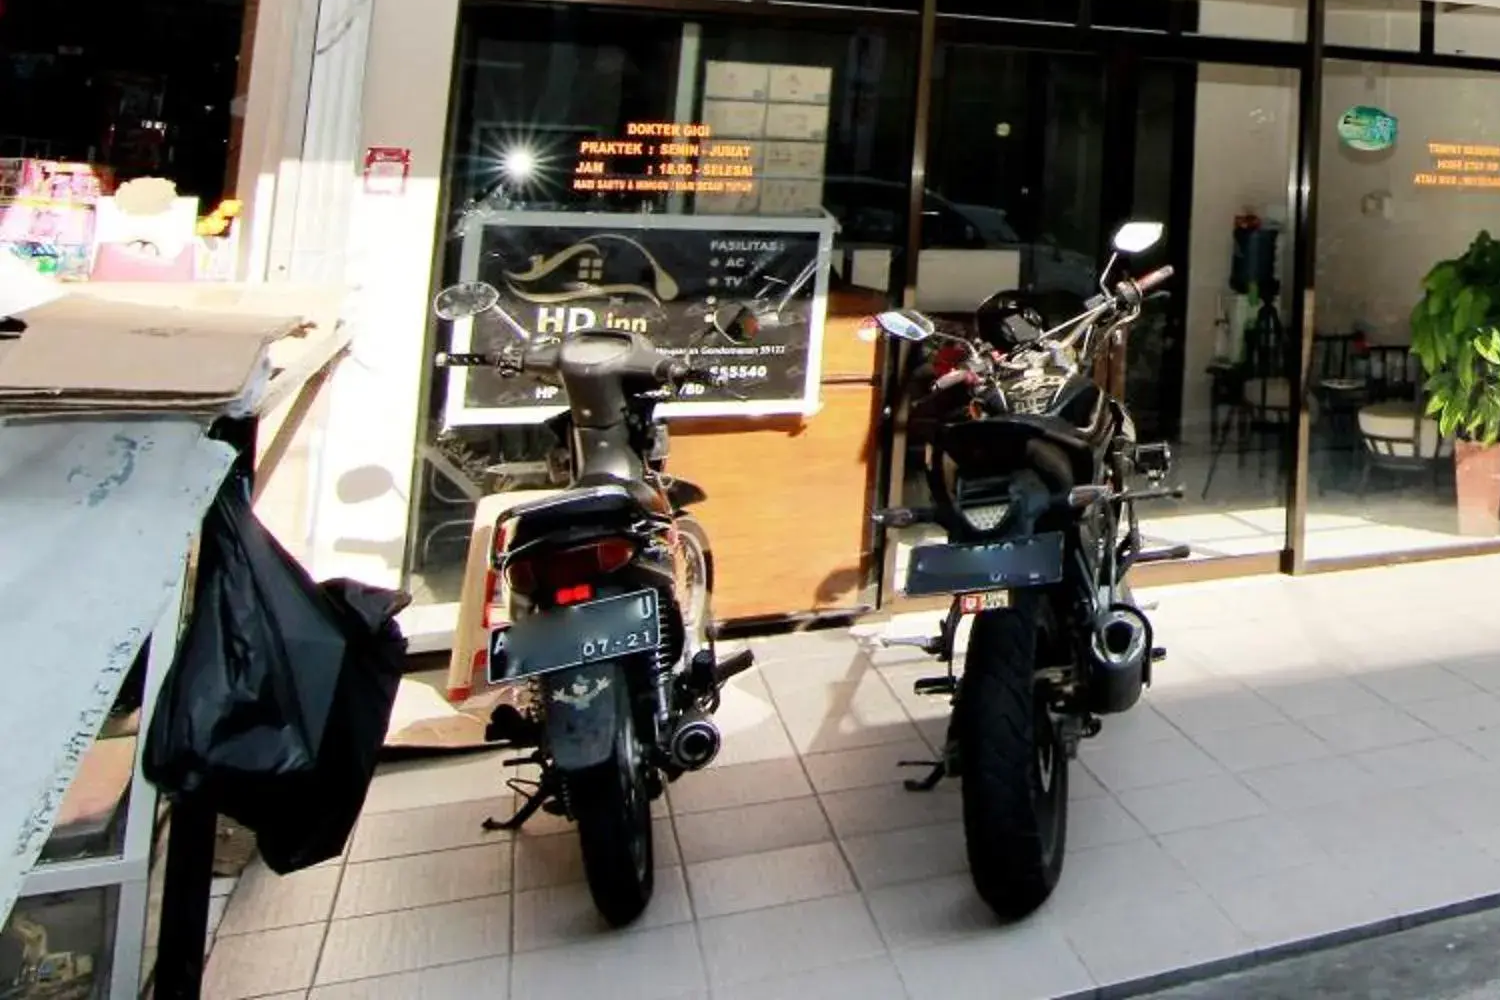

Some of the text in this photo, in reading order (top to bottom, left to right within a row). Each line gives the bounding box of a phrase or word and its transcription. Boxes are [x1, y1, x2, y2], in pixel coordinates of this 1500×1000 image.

[628, 123, 710, 137] DOKTER GIGI
[580, 141, 643, 155] PRAKTEK
[659, 143, 699, 156] SENIN
[575, 162, 605, 174] JAM
[703, 164, 753, 177] SELESAI
[725, 258, 745, 268] AC
[724, 277, 743, 287] TV
[537, 306, 648, 333] HD inn
[535, 385, 559, 399] HP
